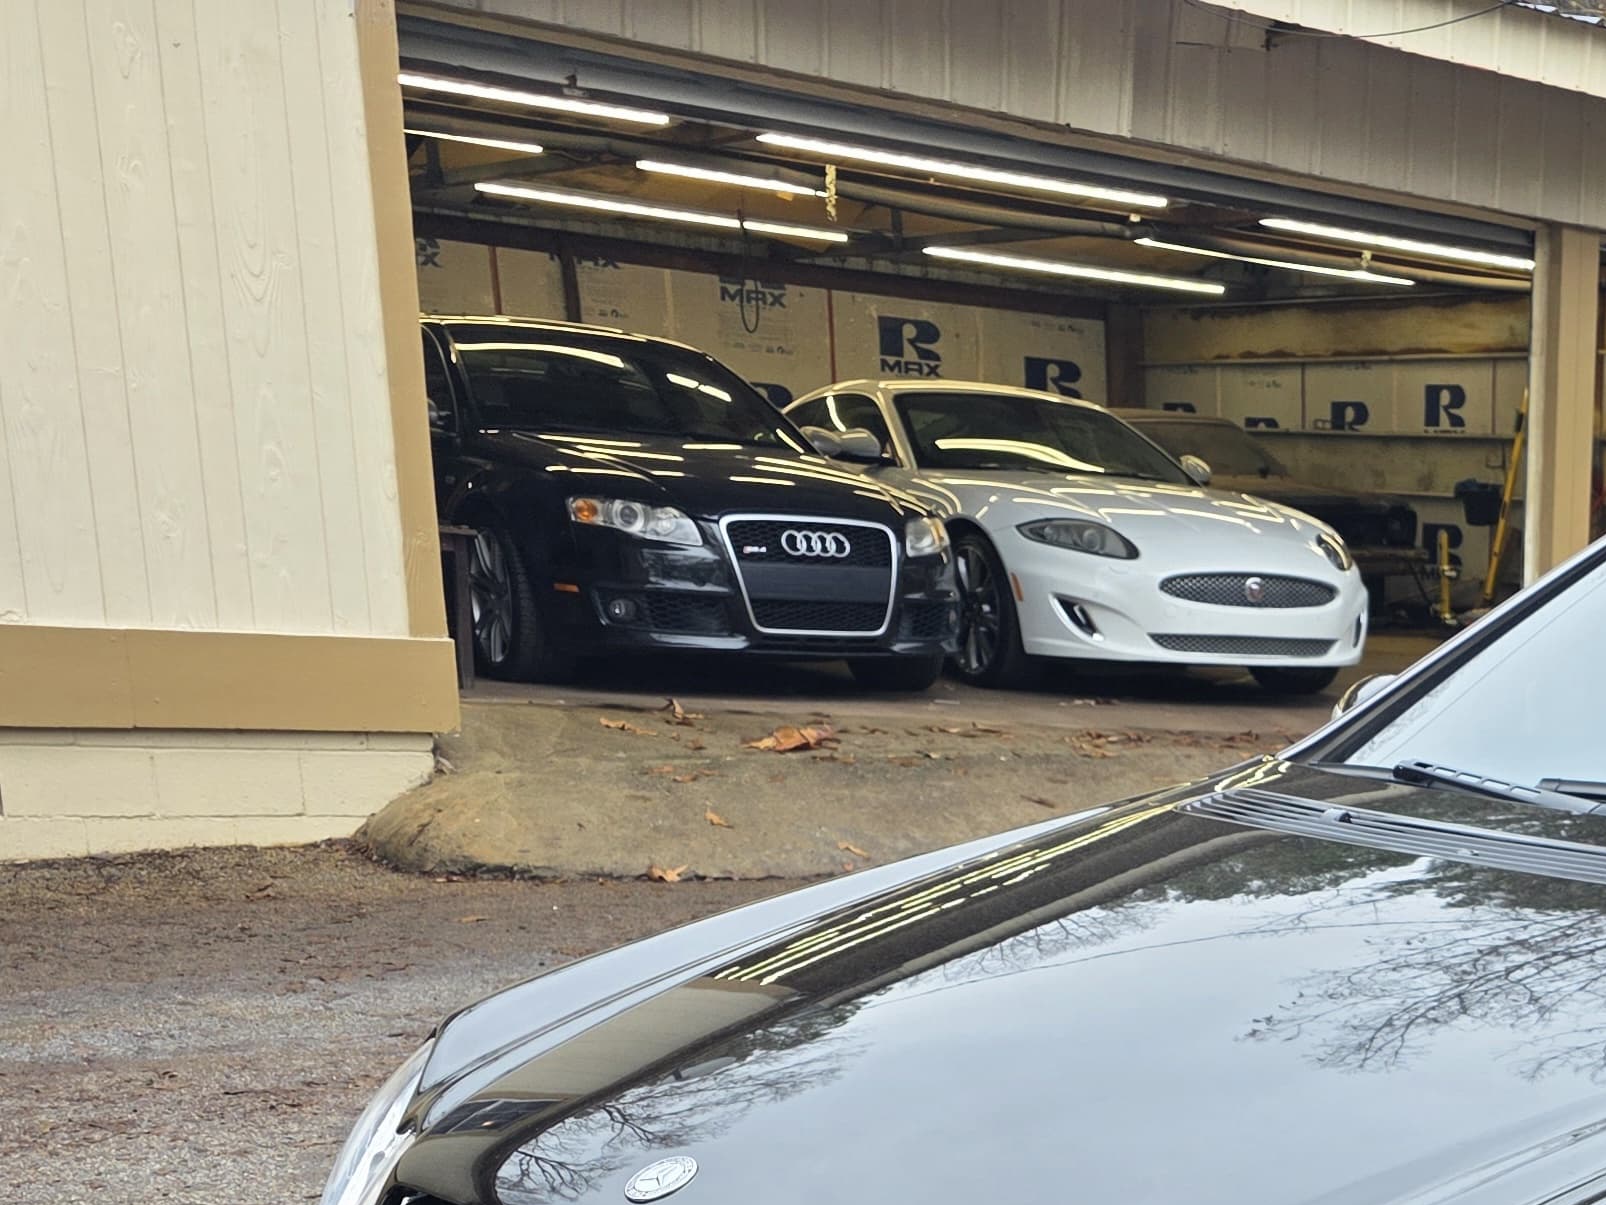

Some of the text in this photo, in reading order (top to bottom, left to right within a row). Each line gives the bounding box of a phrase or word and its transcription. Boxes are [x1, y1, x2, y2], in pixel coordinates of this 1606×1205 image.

[720, 285, 786, 308] MAX
[878, 315, 942, 362] R
[880, 358, 942, 377] MAX
[1024, 356, 1082, 399] R
[1331, 401, 1369, 432] R
[1425, 384, 1466, 428] R
